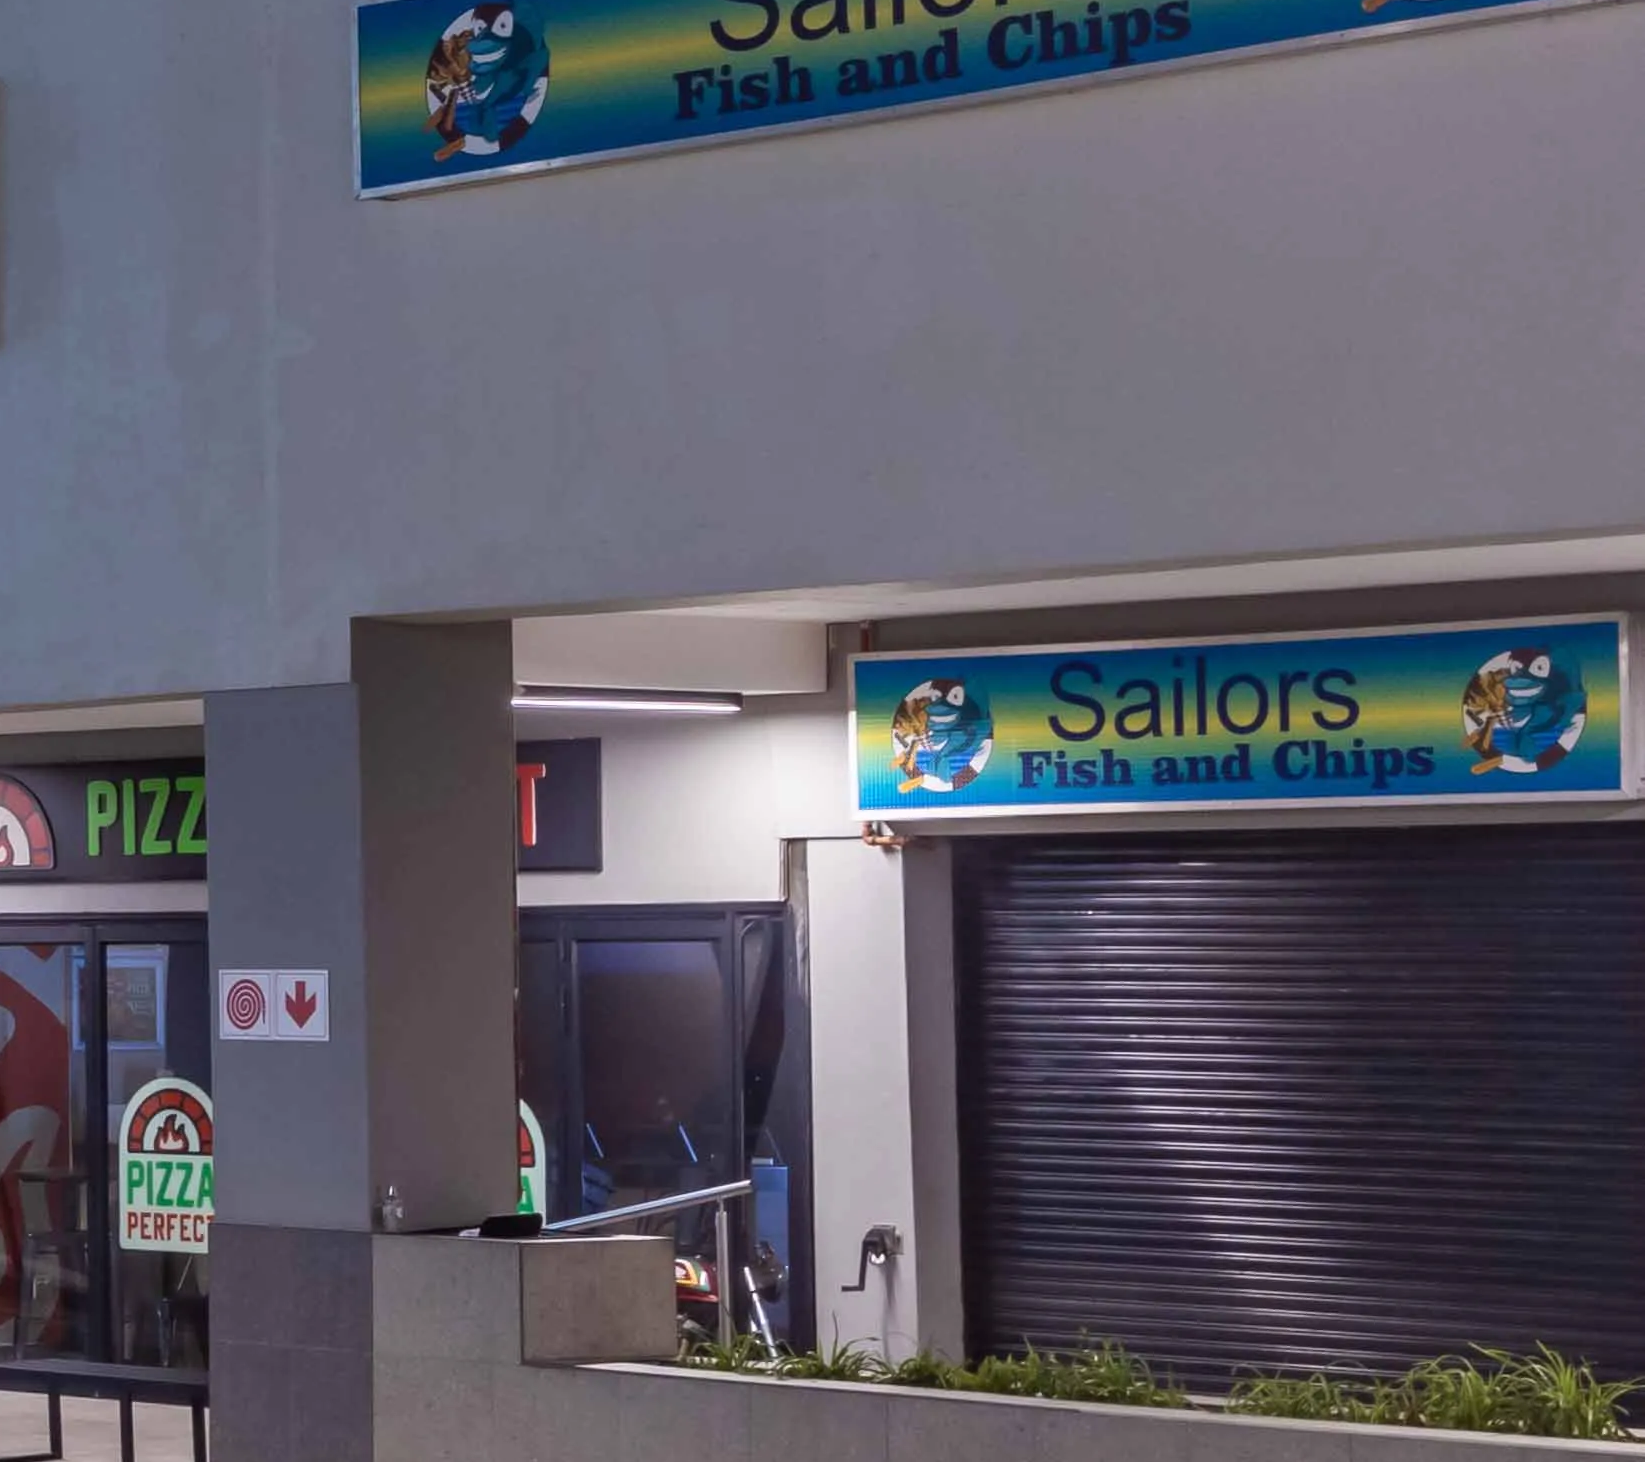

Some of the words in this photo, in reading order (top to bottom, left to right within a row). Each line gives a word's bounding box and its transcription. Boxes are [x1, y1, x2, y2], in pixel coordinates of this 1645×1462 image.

[674, 55, 815, 120] Fish
[837, 28, 962, 97] and
[988, 0, 1192, 68] Chips
[1047, 654, 1362, 742] Sailors
[1018, 748, 1134, 789] Fish
[1152, 744, 1254, 786] and
[1272, 738, 1435, 789] Chips
[87, 776, 207, 857] PIZZ
[127, 1159, 214, 1209] PIZZA
